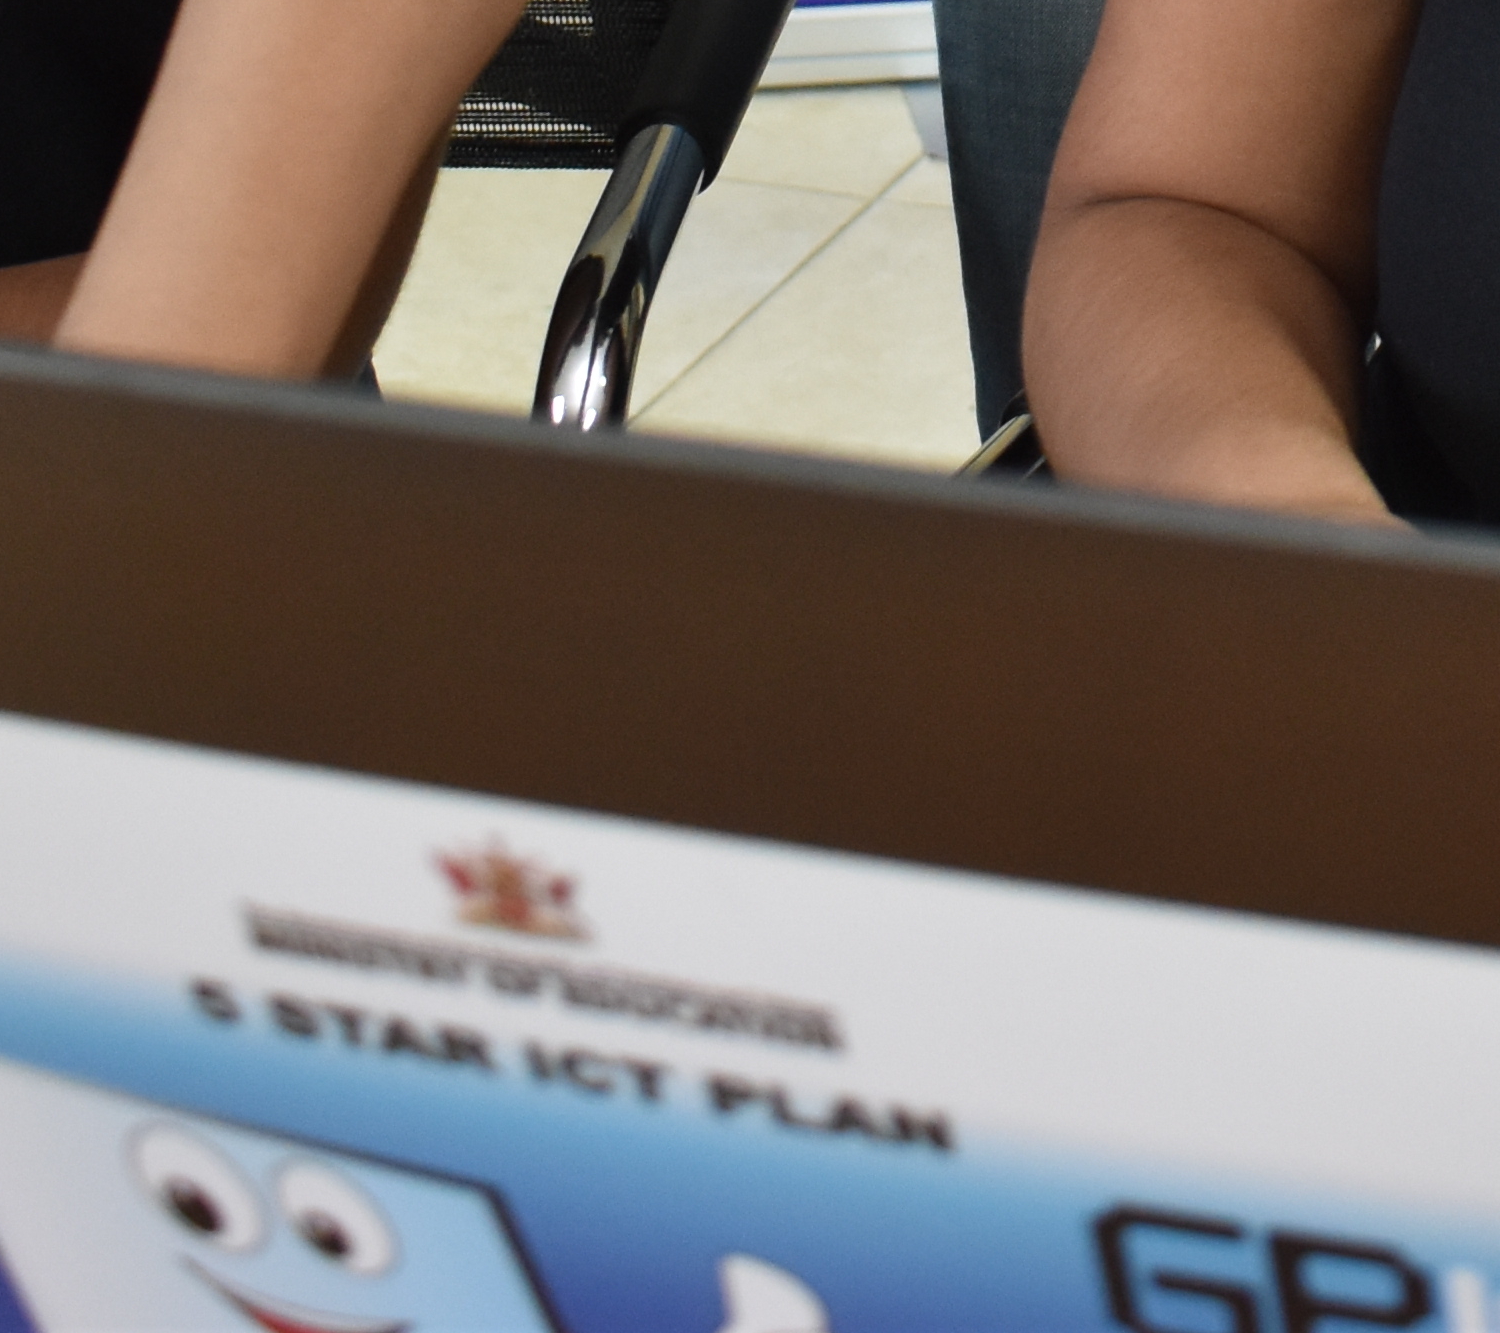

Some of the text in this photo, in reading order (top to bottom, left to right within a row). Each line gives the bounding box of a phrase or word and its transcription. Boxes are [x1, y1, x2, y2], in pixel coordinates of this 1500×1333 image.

[266, 991, 503, 1076] STAR
[524, 1040, 666, 1103] ICT
[706, 1069, 957, 1153] PLAN
